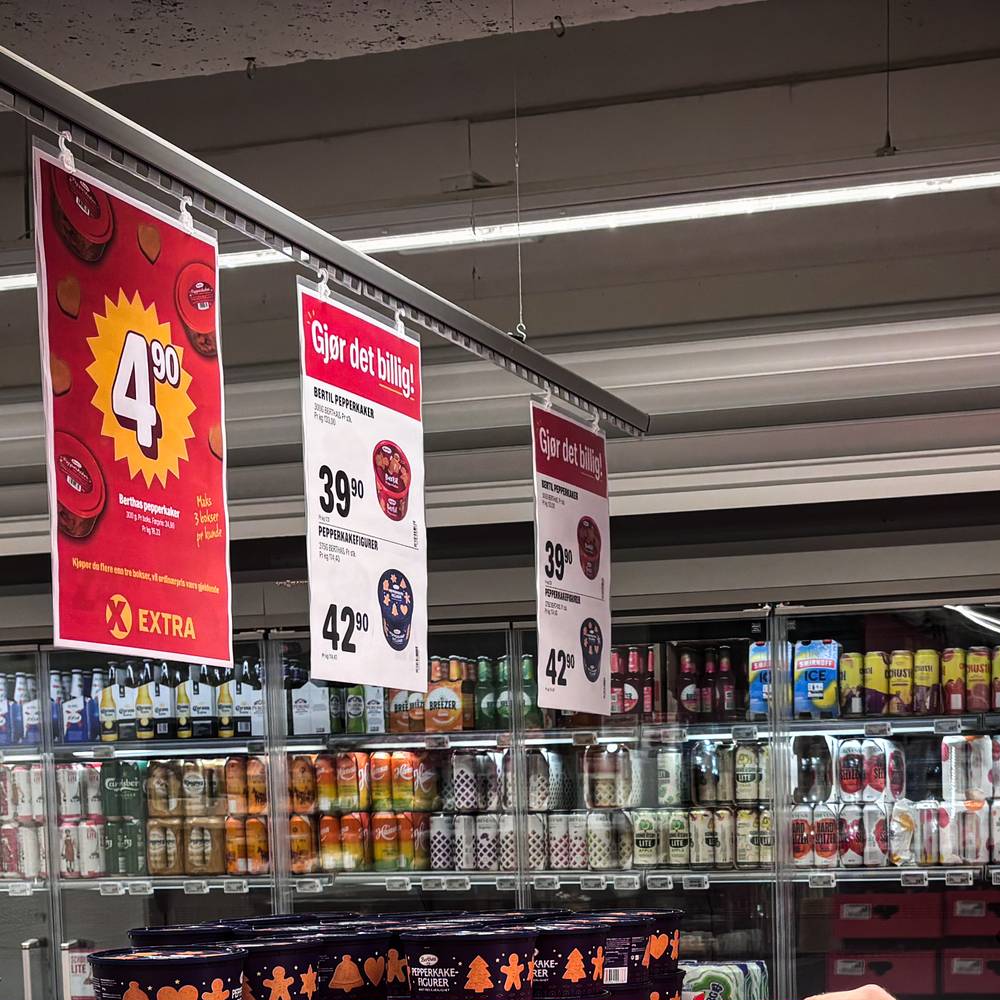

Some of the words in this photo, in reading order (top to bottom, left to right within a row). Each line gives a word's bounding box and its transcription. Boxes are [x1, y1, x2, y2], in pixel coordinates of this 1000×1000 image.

[311, 320, 346, 364] Gjør
[350, 337, 375, 376] det
[377, 347, 415, 398] billig!
[313, 386, 334, 404] BERTIL
[335, 395, 375, 419] PEPPERKAKER
[539, 426, 561, 461] Gjør
[562, 437, 578, 467] det
[579, 443, 603, 480] billig!
[119, 493, 143, 510] Berthas
[143, 500, 180, 519] pepperkaker
[196, 493, 212, 508] Maks
[194, 512, 199, 526] 3
[200, 511, 219, 524] bokser
[196, 531, 204, 548] pr
[205, 525, 222, 539] kunde
[319, 525, 379, 551] PEPPERKAKEFIGURER
[139, 609, 196, 639] EXTRA
[799, 660, 833, 668] SMIRNOFF
[805, 670, 827, 681] ICE
[429, 700, 457, 711] BREEZER
[639, 839, 652, 847] LITE
[671, 839, 683, 847] LITE
[71, 964, 87, 974] LITE
[411, 967, 459, 978] PEPPERKAKE-
[417, 977, 450, 988] FIGURER
